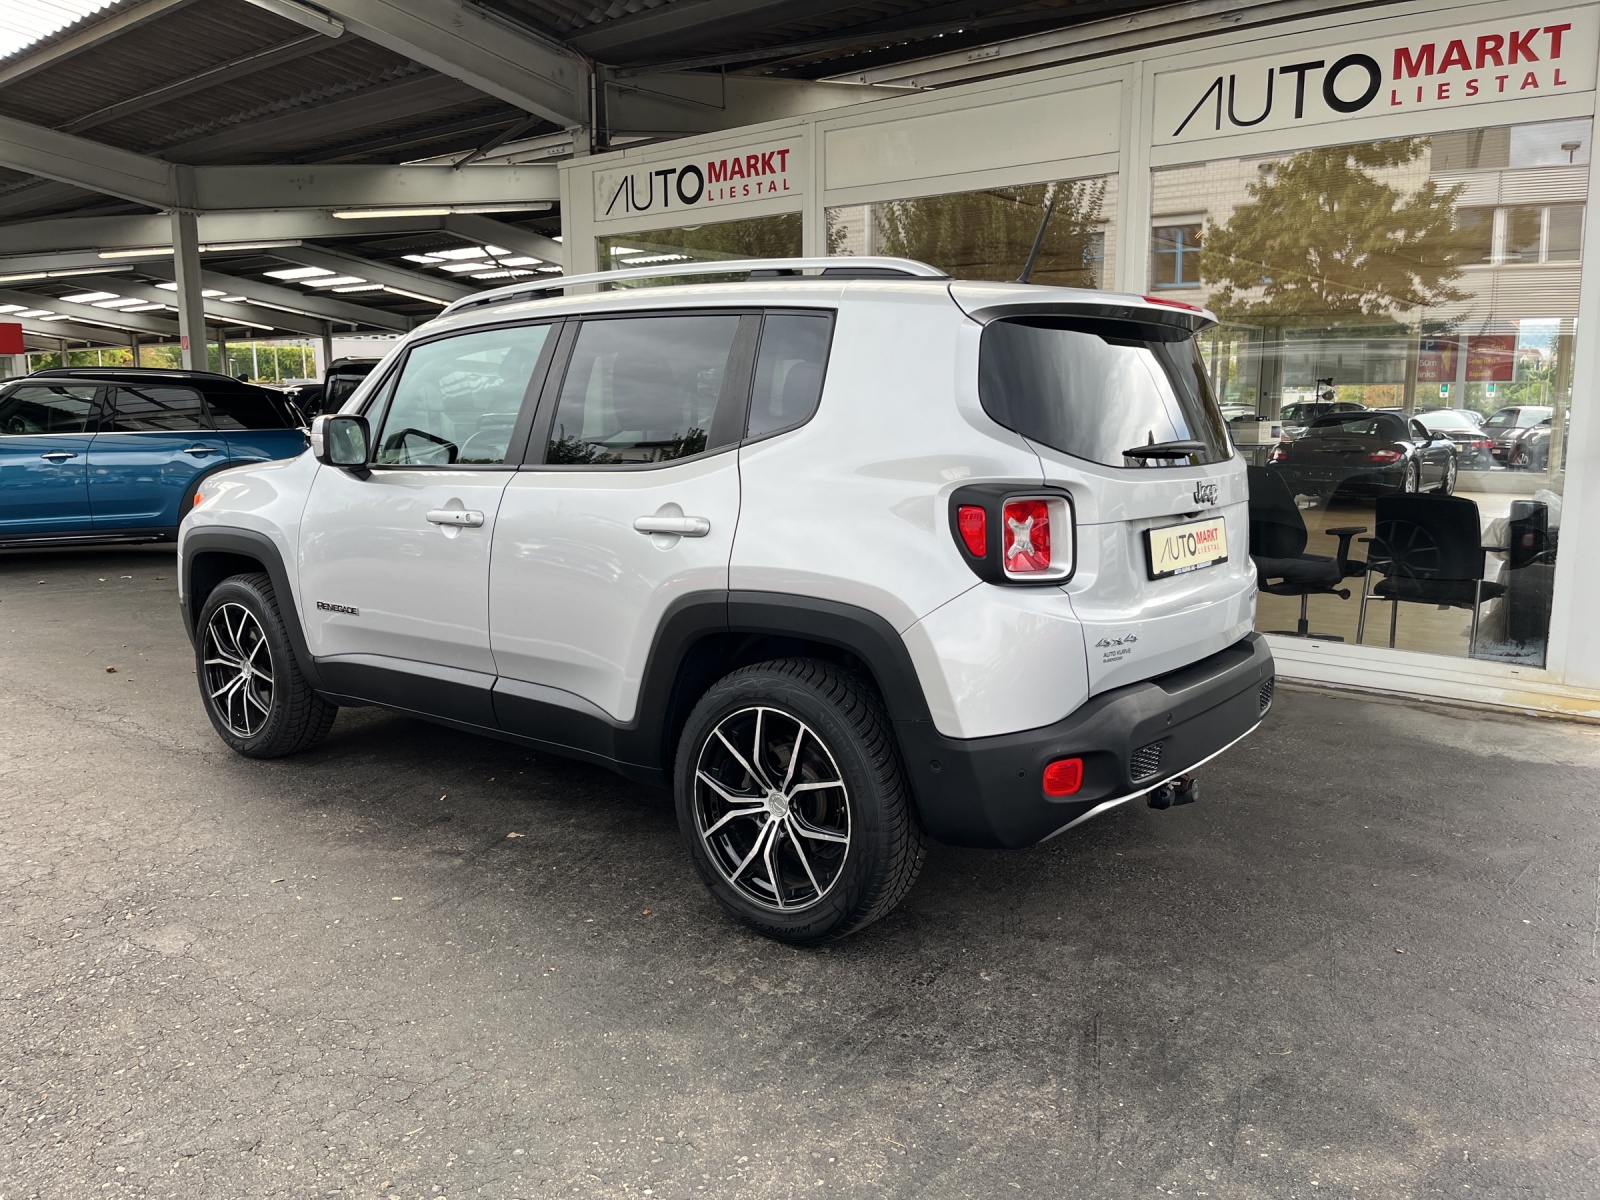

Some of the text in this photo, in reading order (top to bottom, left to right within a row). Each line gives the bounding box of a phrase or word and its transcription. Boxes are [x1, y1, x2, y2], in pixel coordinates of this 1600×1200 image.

[1172, 23, 1572, 137] AUTO MARKT
[1390, 67, 1568, 107] LIESTAL
[605, 148, 790, 216] AUTO MARKT
[707, 178, 790, 202] LIESTAL
[1193, 481, 1218, 505] Jeep
[1160, 527, 1218, 563] AUTO MARKT
[1197, 543, 1220, 555] LIESTAL
[316, 600, 360, 616] RENEGADE
[1103, 650, 1116, 658] AUTO
